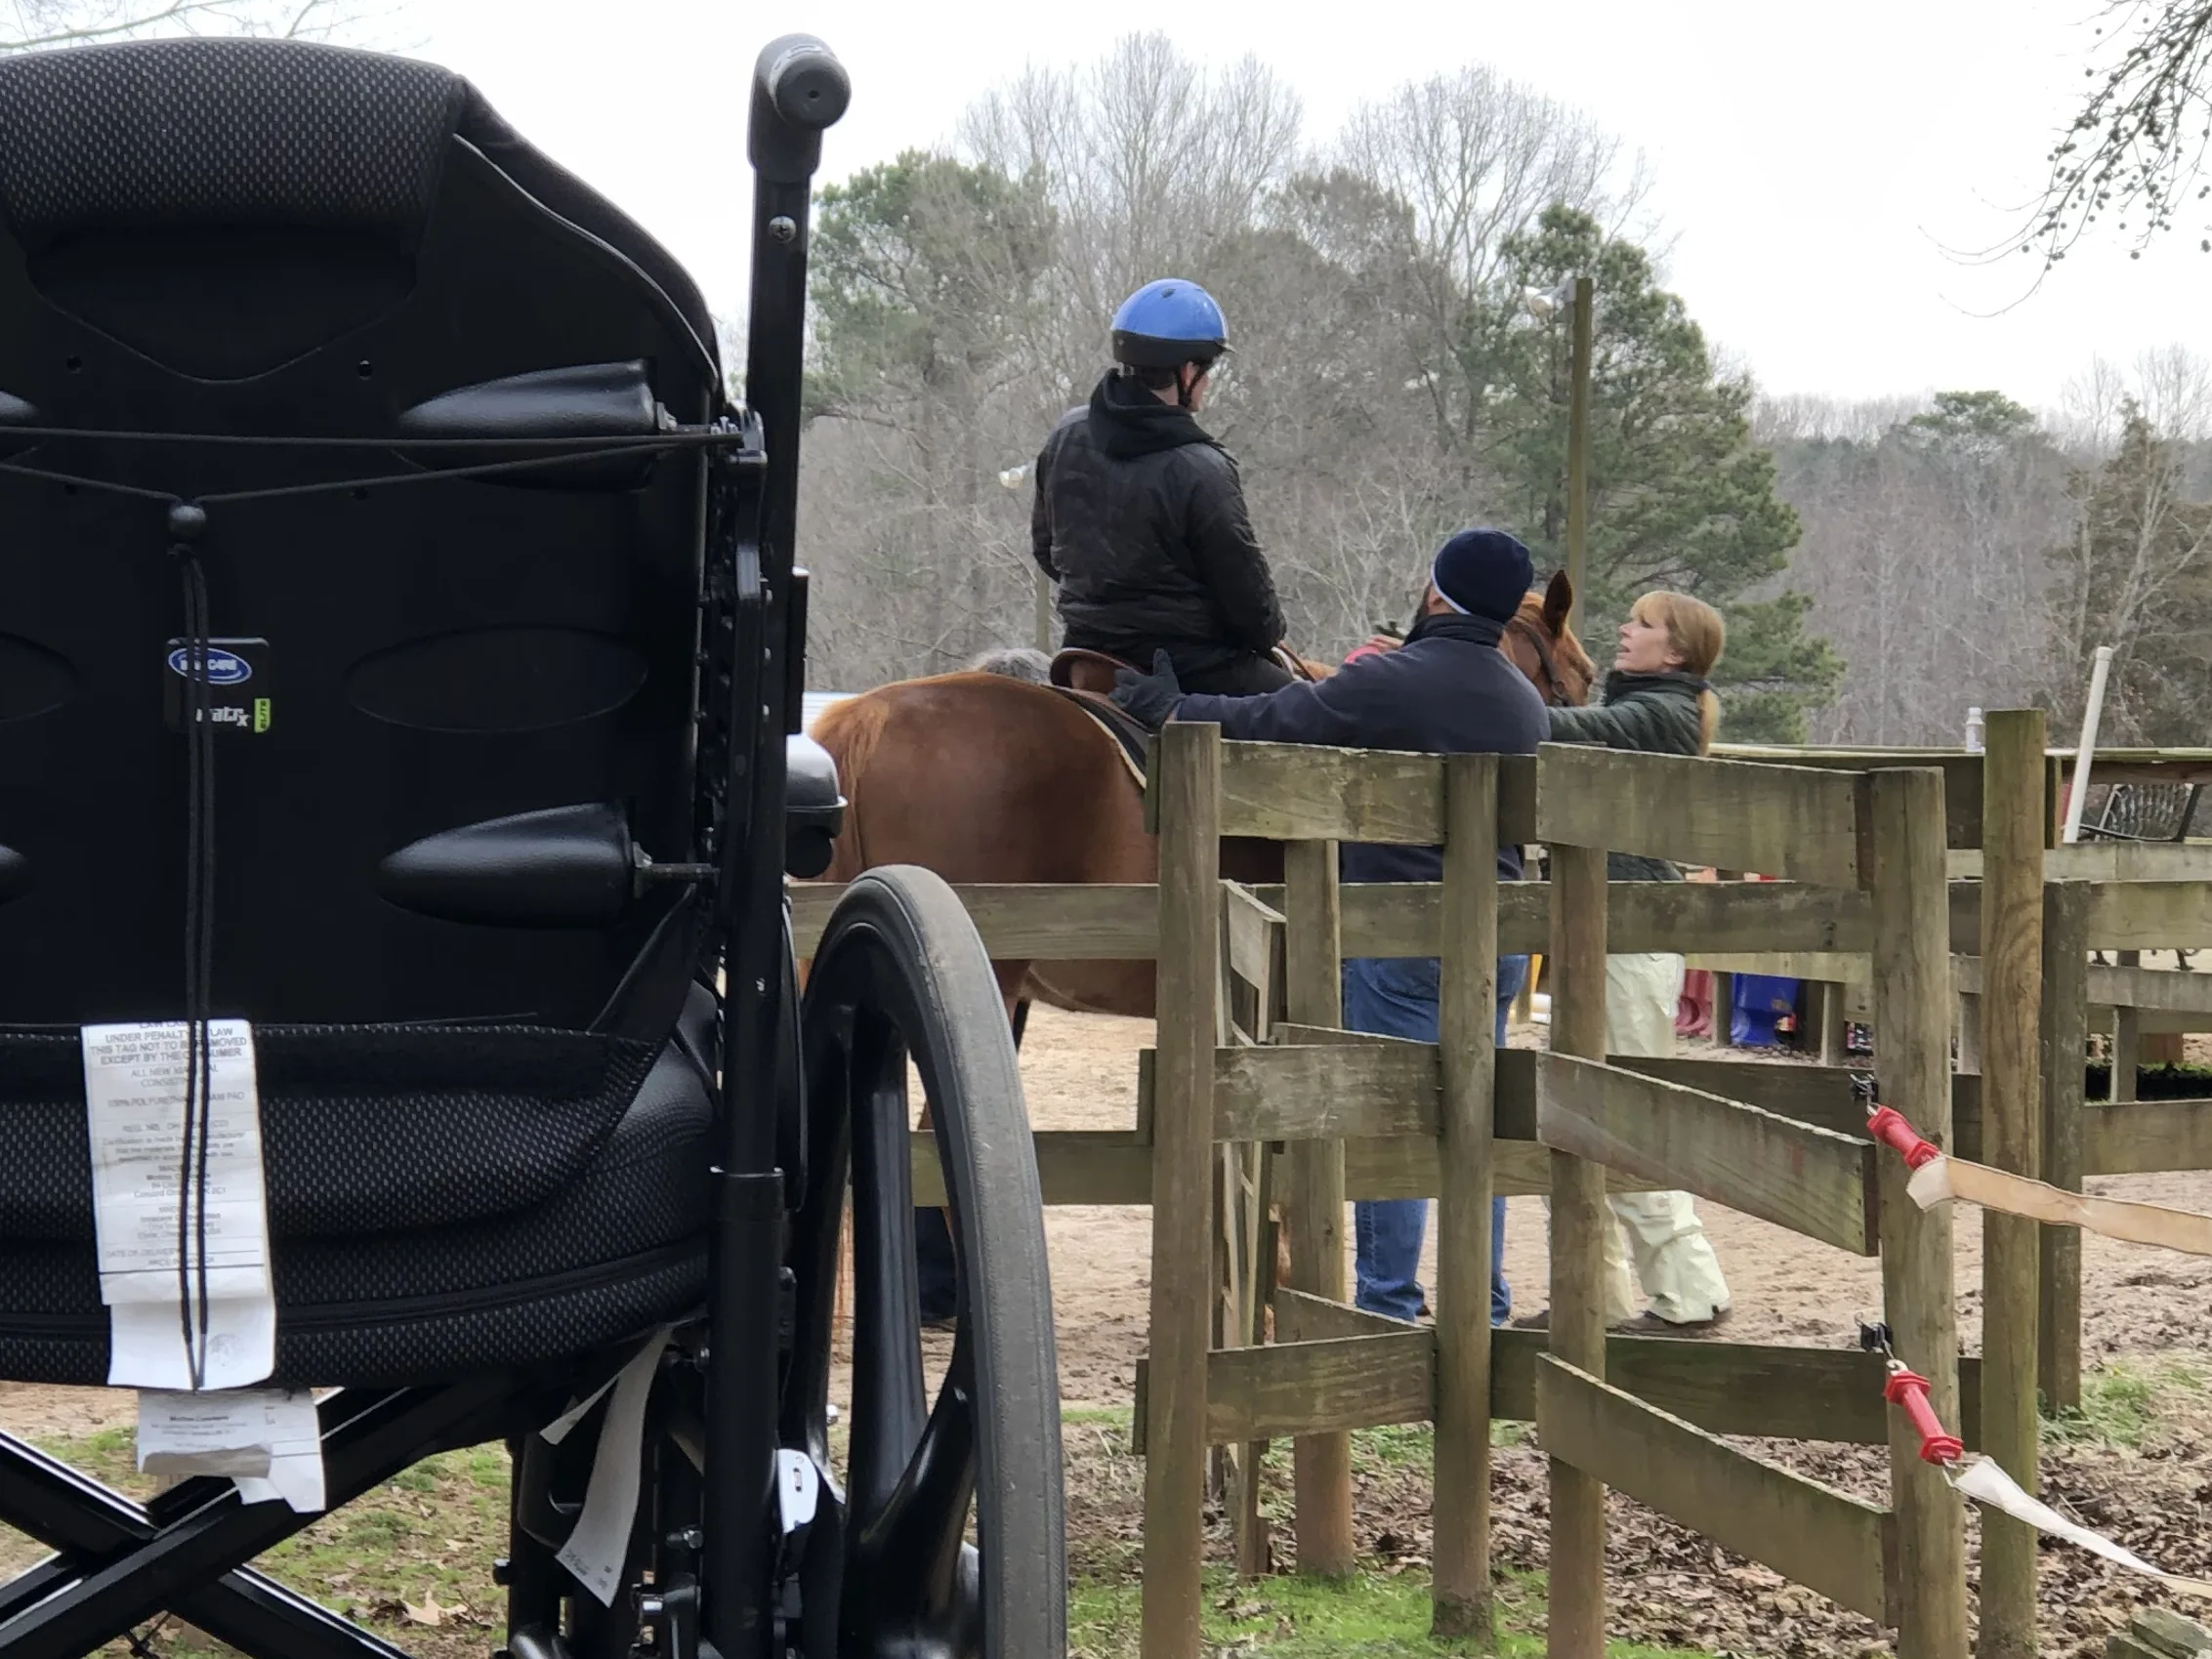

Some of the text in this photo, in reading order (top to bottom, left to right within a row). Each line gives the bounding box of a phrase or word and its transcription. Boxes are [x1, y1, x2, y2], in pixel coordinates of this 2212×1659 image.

[210, 1027, 233, 1037] LAW
[105, 1033, 142, 1044] UNDER
[90, 1046, 113, 1056] THIS
[115, 1044, 137, 1054] TAG
[140, 1042, 161, 1052] NOT
[164, 1040, 178, 1051] TO
[101, 1055, 140, 1065] EXCEPT
[144, 1053, 157, 1062] BY
[160, 1052, 182, 1061] THE
